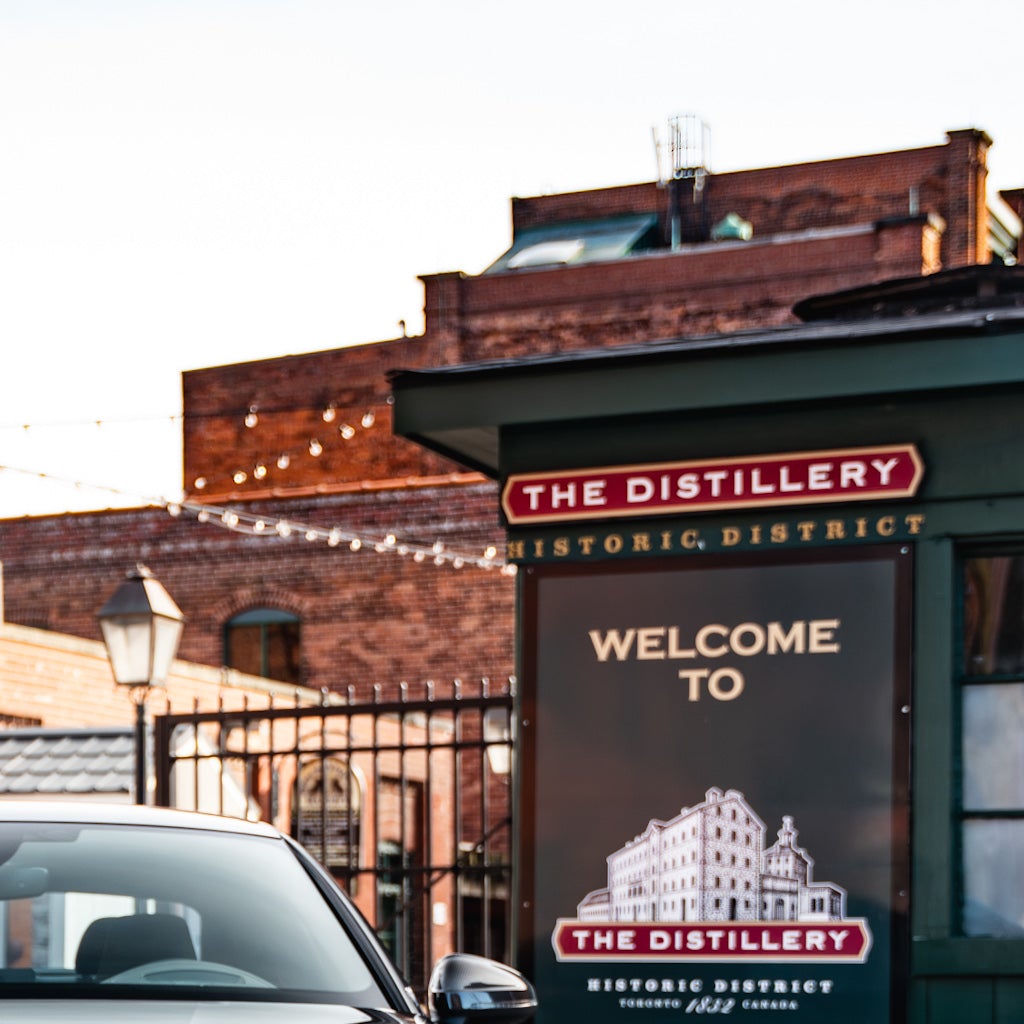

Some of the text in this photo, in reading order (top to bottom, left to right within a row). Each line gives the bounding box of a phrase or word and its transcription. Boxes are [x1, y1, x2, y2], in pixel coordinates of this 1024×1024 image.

[522, 457, 900, 511] THE DISTILLERY
[507, 514, 927, 560] HISTORIC DISTRICT
[588, 619, 841, 662] WELCOME
[678, 667, 745, 702] TO
[572, 930, 849, 951] THE DISTILLERY
[587, 978, 834, 994] HISTORIC DISTRICT
[619, 995, 799, 1014] TORONTO 1832 CANADA
